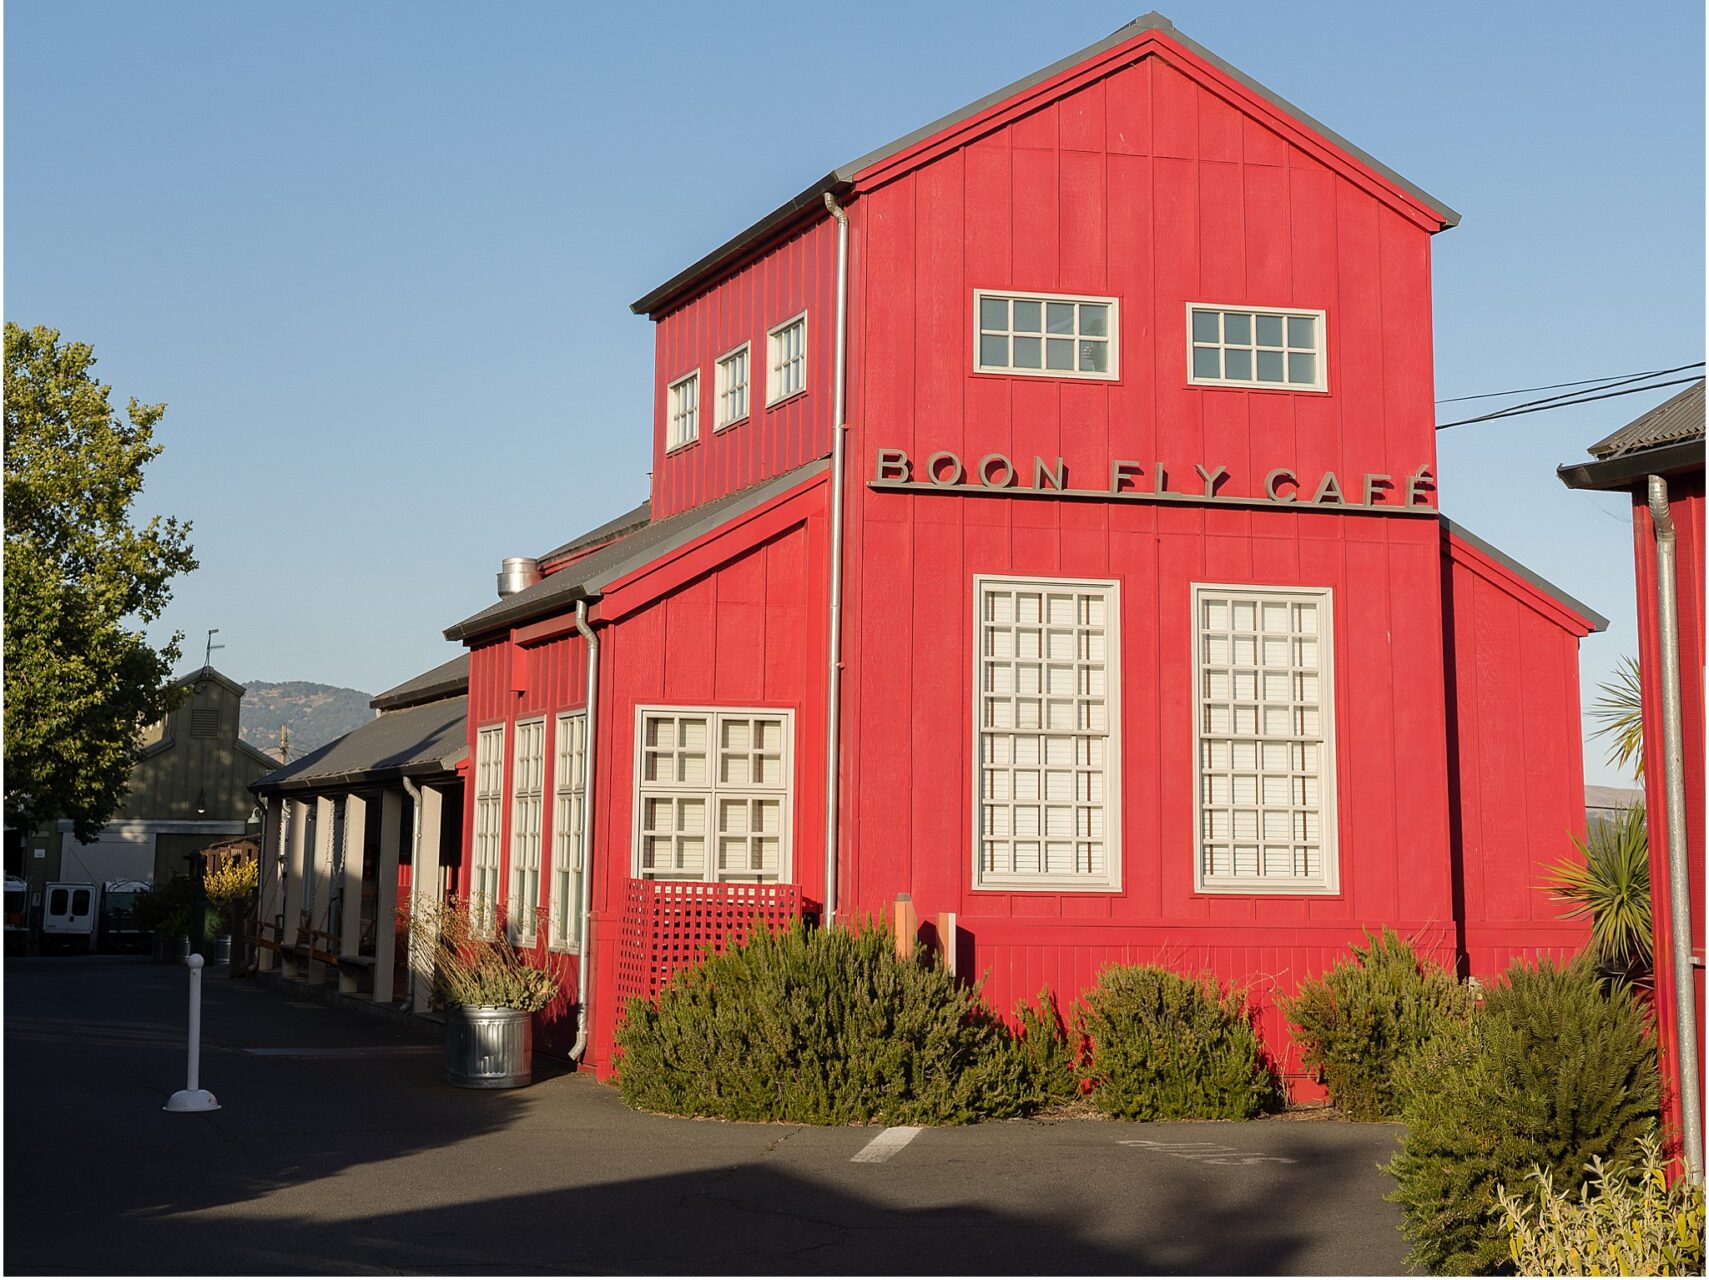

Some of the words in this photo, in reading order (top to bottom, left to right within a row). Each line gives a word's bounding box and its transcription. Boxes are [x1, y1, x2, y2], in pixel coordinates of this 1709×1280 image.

[876, 447, 1064, 491] BOON
[1110, 459, 1227, 498] FLY
[1264, 464, 1434, 508] CAFÉ
